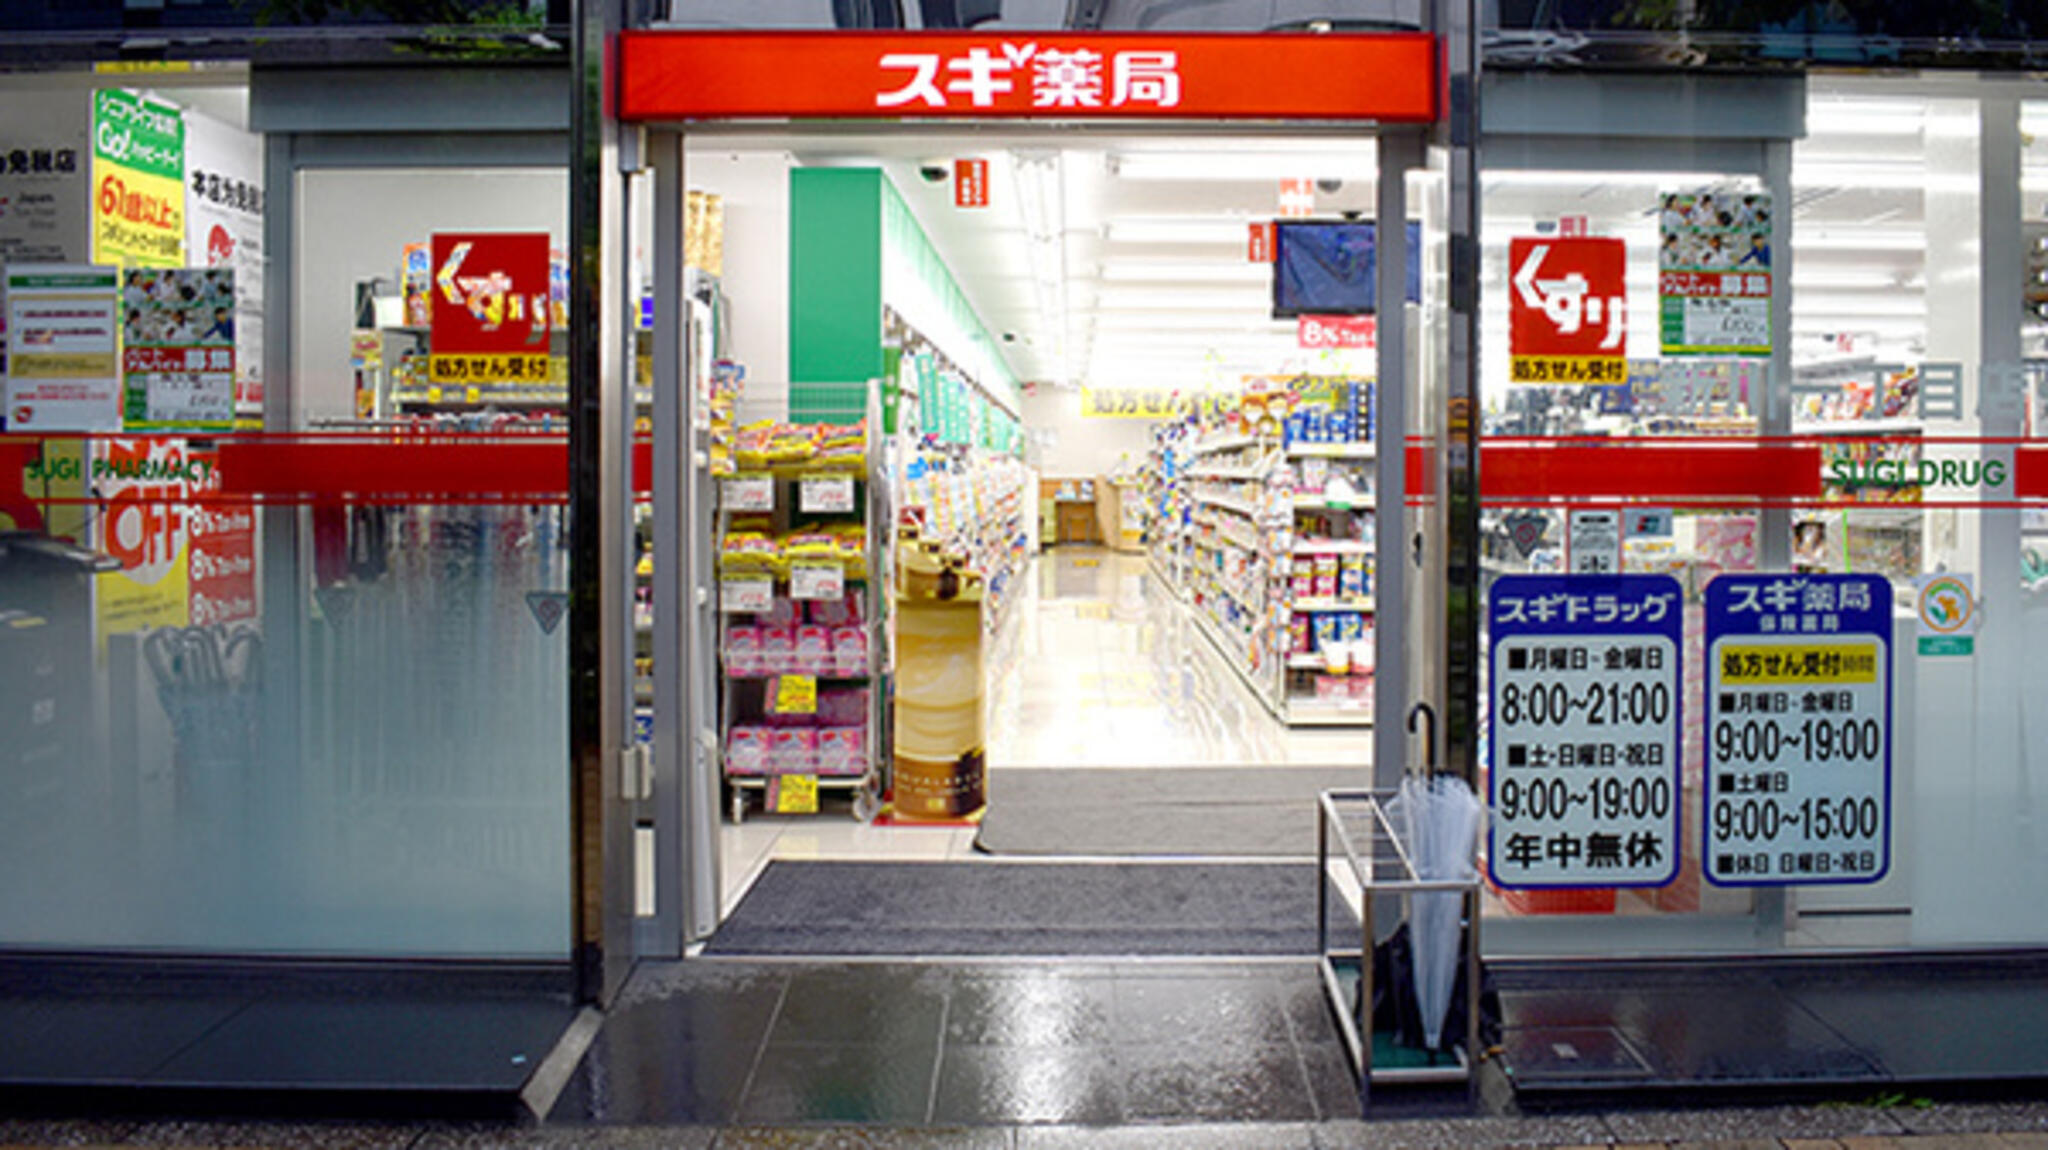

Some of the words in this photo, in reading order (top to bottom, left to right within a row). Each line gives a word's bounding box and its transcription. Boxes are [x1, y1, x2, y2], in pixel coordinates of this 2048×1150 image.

[876, 42, 1180, 107] スギ薬局
[434, 357, 548, 378] 処方せん受付
[1514, 359, 1623, 380] 処方せん受付
[27, 457, 80, 479] SUGI
[92, 458, 213, 480] PHARMACY
[1832, 459, 1906, 486] SUGI
[1918, 459, 2007, 486] DRUG
[1496, 592, 1676, 622] スギドラッグ
[1727, 578, 1872, 613] スギ薬局
[1737, 771, 1789, 794] 土曜日
[1504, 831, 1663, 870] 年中無休
